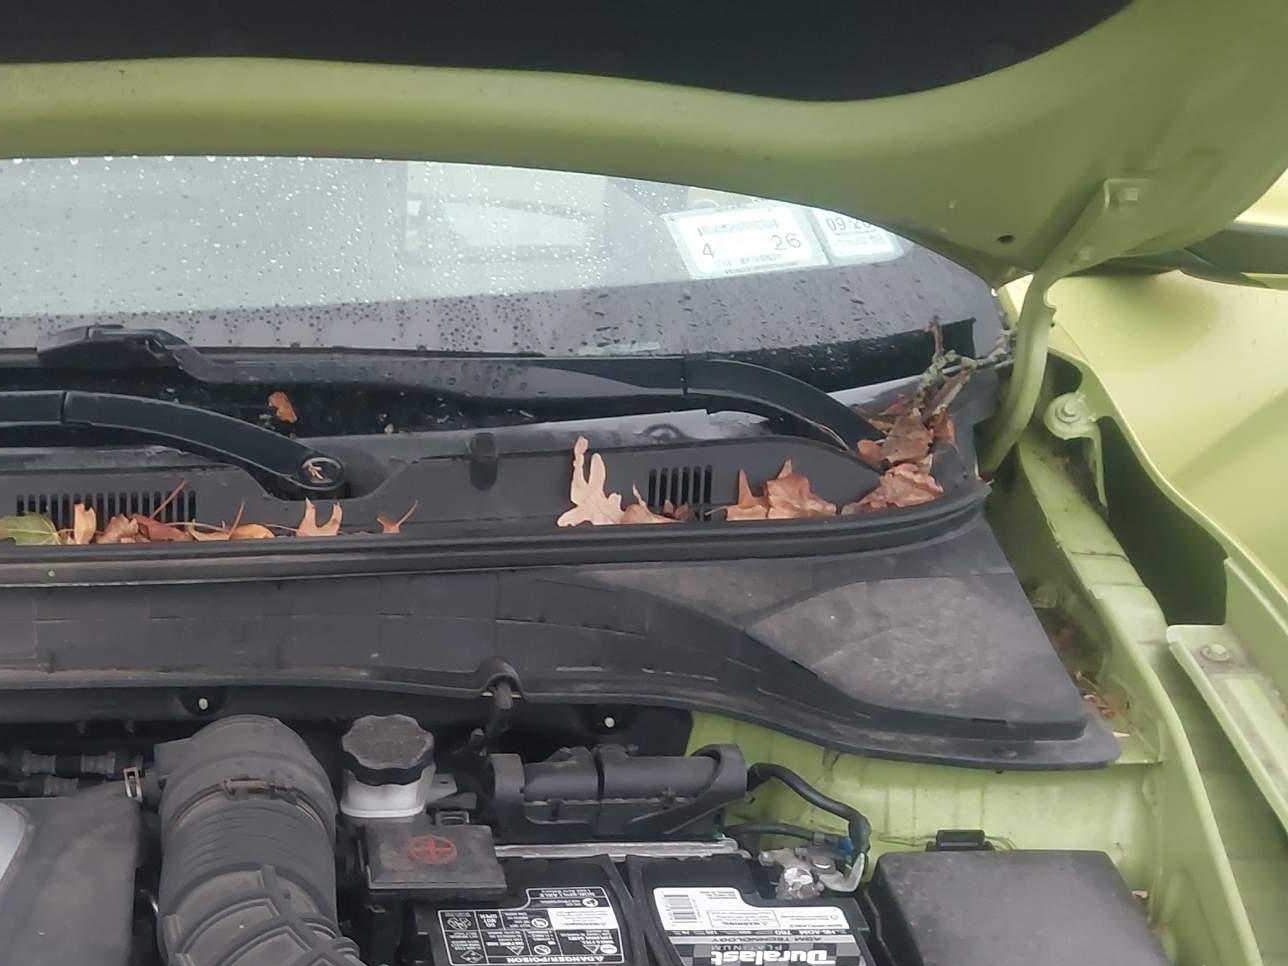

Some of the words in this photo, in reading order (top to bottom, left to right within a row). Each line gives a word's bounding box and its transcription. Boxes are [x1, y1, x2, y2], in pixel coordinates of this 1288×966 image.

[702, 242, 715, 258] 4
[770, 232, 802, 251] 26
[710, 949, 837, 966] Duralast
